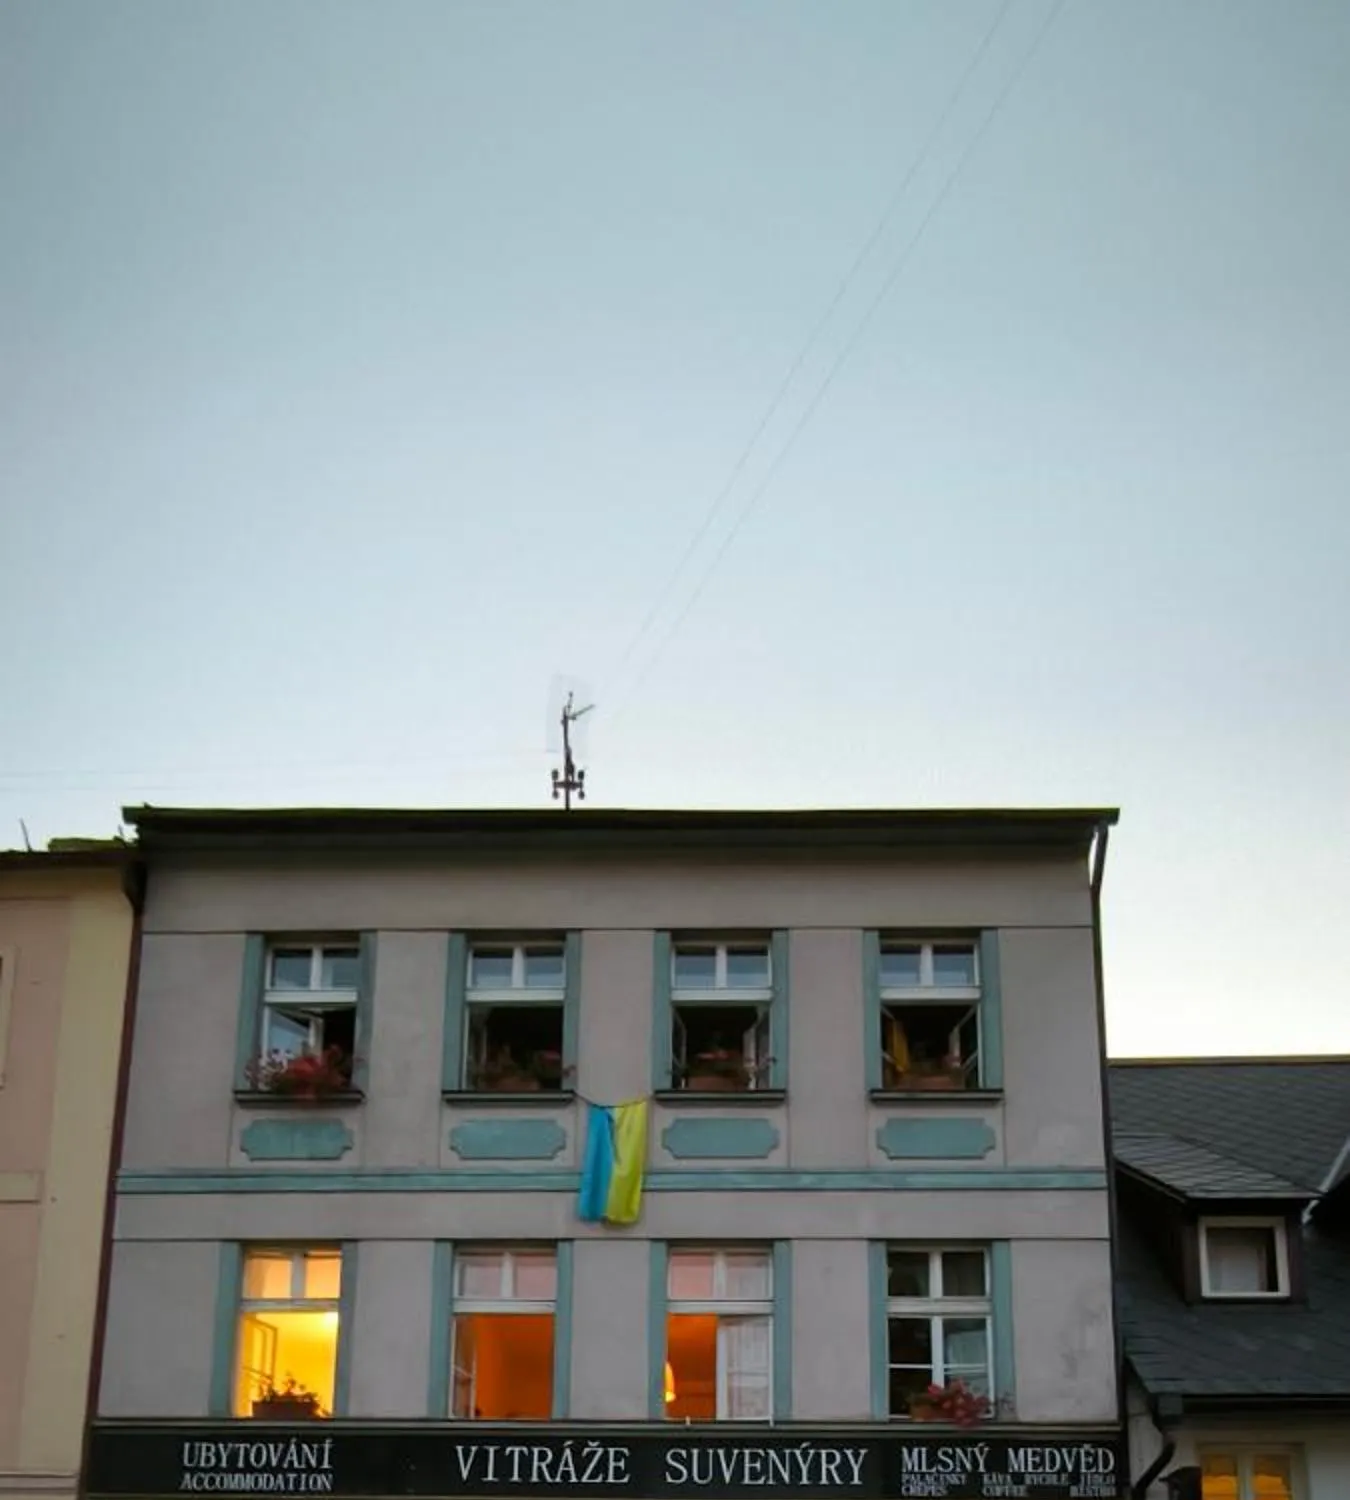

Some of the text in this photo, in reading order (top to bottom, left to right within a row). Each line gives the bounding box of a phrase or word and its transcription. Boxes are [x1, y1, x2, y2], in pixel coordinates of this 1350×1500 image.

[182, 1438, 334, 1469] UBYTOVÁNÍ
[456, 1440, 868, 1486] VITRÁŽE SUVENÝRY
[901, 1443, 1115, 1473] MLSNÝ MEDVĚD
[179, 1473, 334, 1491] ACCOMMODATION
